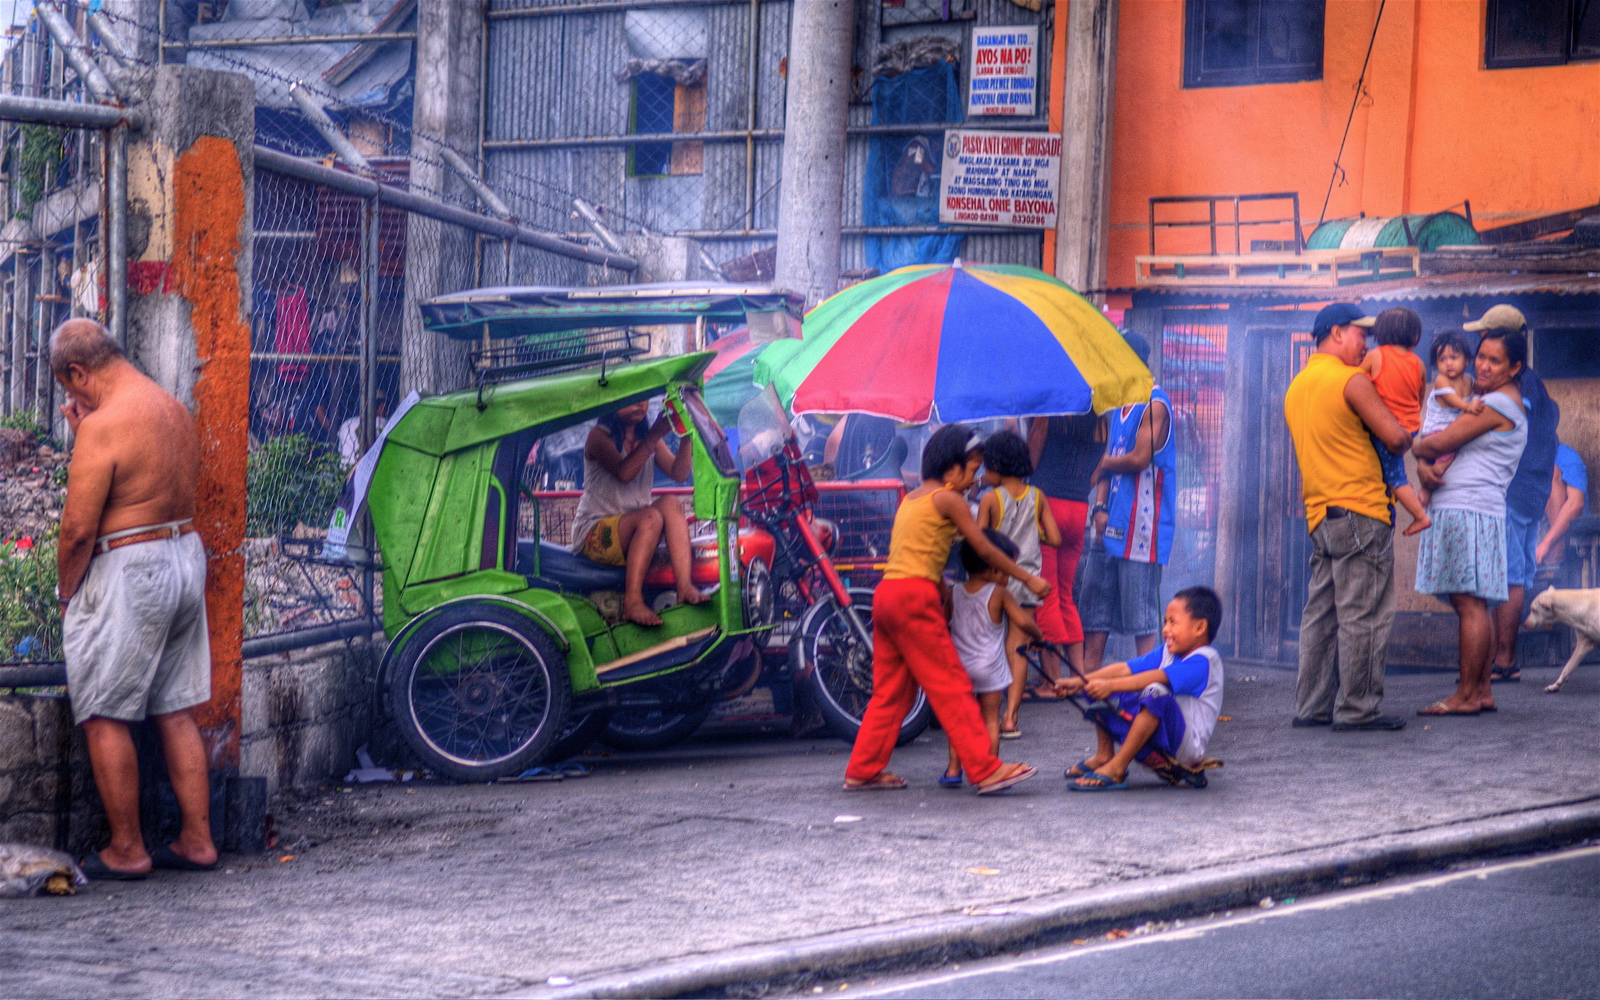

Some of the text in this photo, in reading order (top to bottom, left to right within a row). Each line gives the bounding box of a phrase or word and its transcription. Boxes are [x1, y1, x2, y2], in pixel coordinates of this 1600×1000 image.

[1008, 34, 1016, 46] NA
[976, 47, 1032, 65] AYOS NA PO!
[1010, 92, 1032, 104] BAYONA
[962, 136, 1061, 157] PASAY ANTI CRIME CRUSADE
[959, 156, 1049, 168] MAGLAKAD KASAMA NG MGA
[1002, 168, 1010, 176] AT
[1013, 168, 1037, 177] NAAAPI
[954, 176, 961, 184] AT
[1022, 179, 1031, 188] NG
[1034, 180, 1048, 188] MGA
[948, 186, 966, 195] TAONG
[1000, 189, 1008, 197] NG
[947, 196, 1055, 215] KONSEHAL ONIE BAYONA
